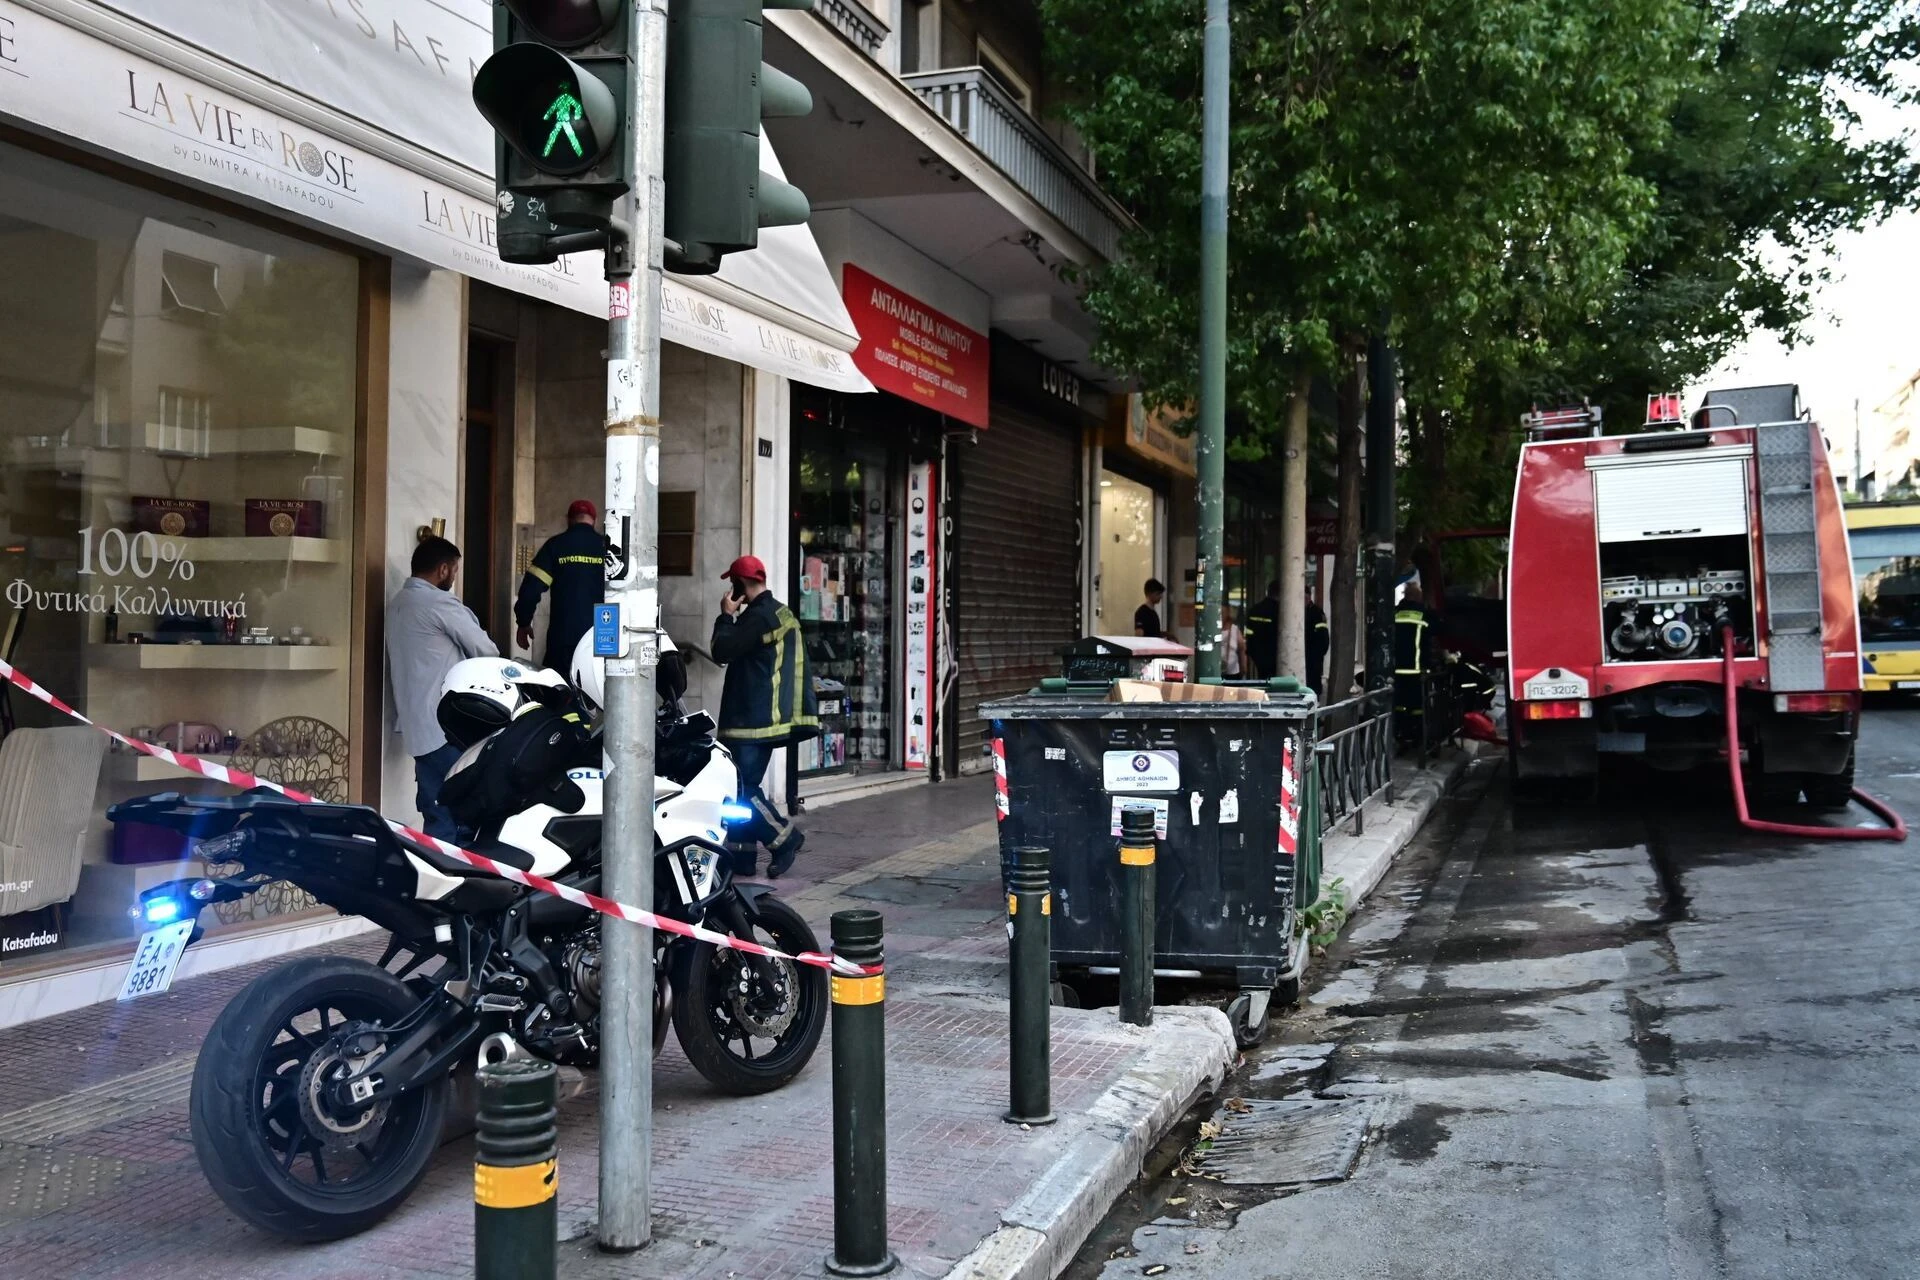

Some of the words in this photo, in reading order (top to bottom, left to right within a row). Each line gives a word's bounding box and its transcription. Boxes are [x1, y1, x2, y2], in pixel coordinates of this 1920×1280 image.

[126, 69, 176, 125] LA
[184, 93, 247, 150] VIE
[252, 127, 274, 153] EN
[280, 130, 357, 193] ROSE
[174, 143, 189, 160] by
[193, 150, 250, 177] DIMITRA
[255, 172, 335, 210] KATSAFADOU
[423, 189, 454, 232] LA
[459, 205, 498, 249] VIE
[465, 251, 501, 272] DIMITRA
[687, 296, 728, 333] ROSE
[870, 287, 935, 337] ΑΝΤΑΛΛΑΓΜΑ
[937, 321, 972, 354] ΚΙΝΗΤΟΥ
[758, 325, 776, 351] LA
[777, 332, 800, 360] VIE
[77, 525, 195, 582] 100%
[5, 578, 109, 614] Φυτικά
[113, 584, 248, 620] Καλλυντικά
[2, 930, 58, 952] Katsafadou
[128, 964, 167, 995] 9881
